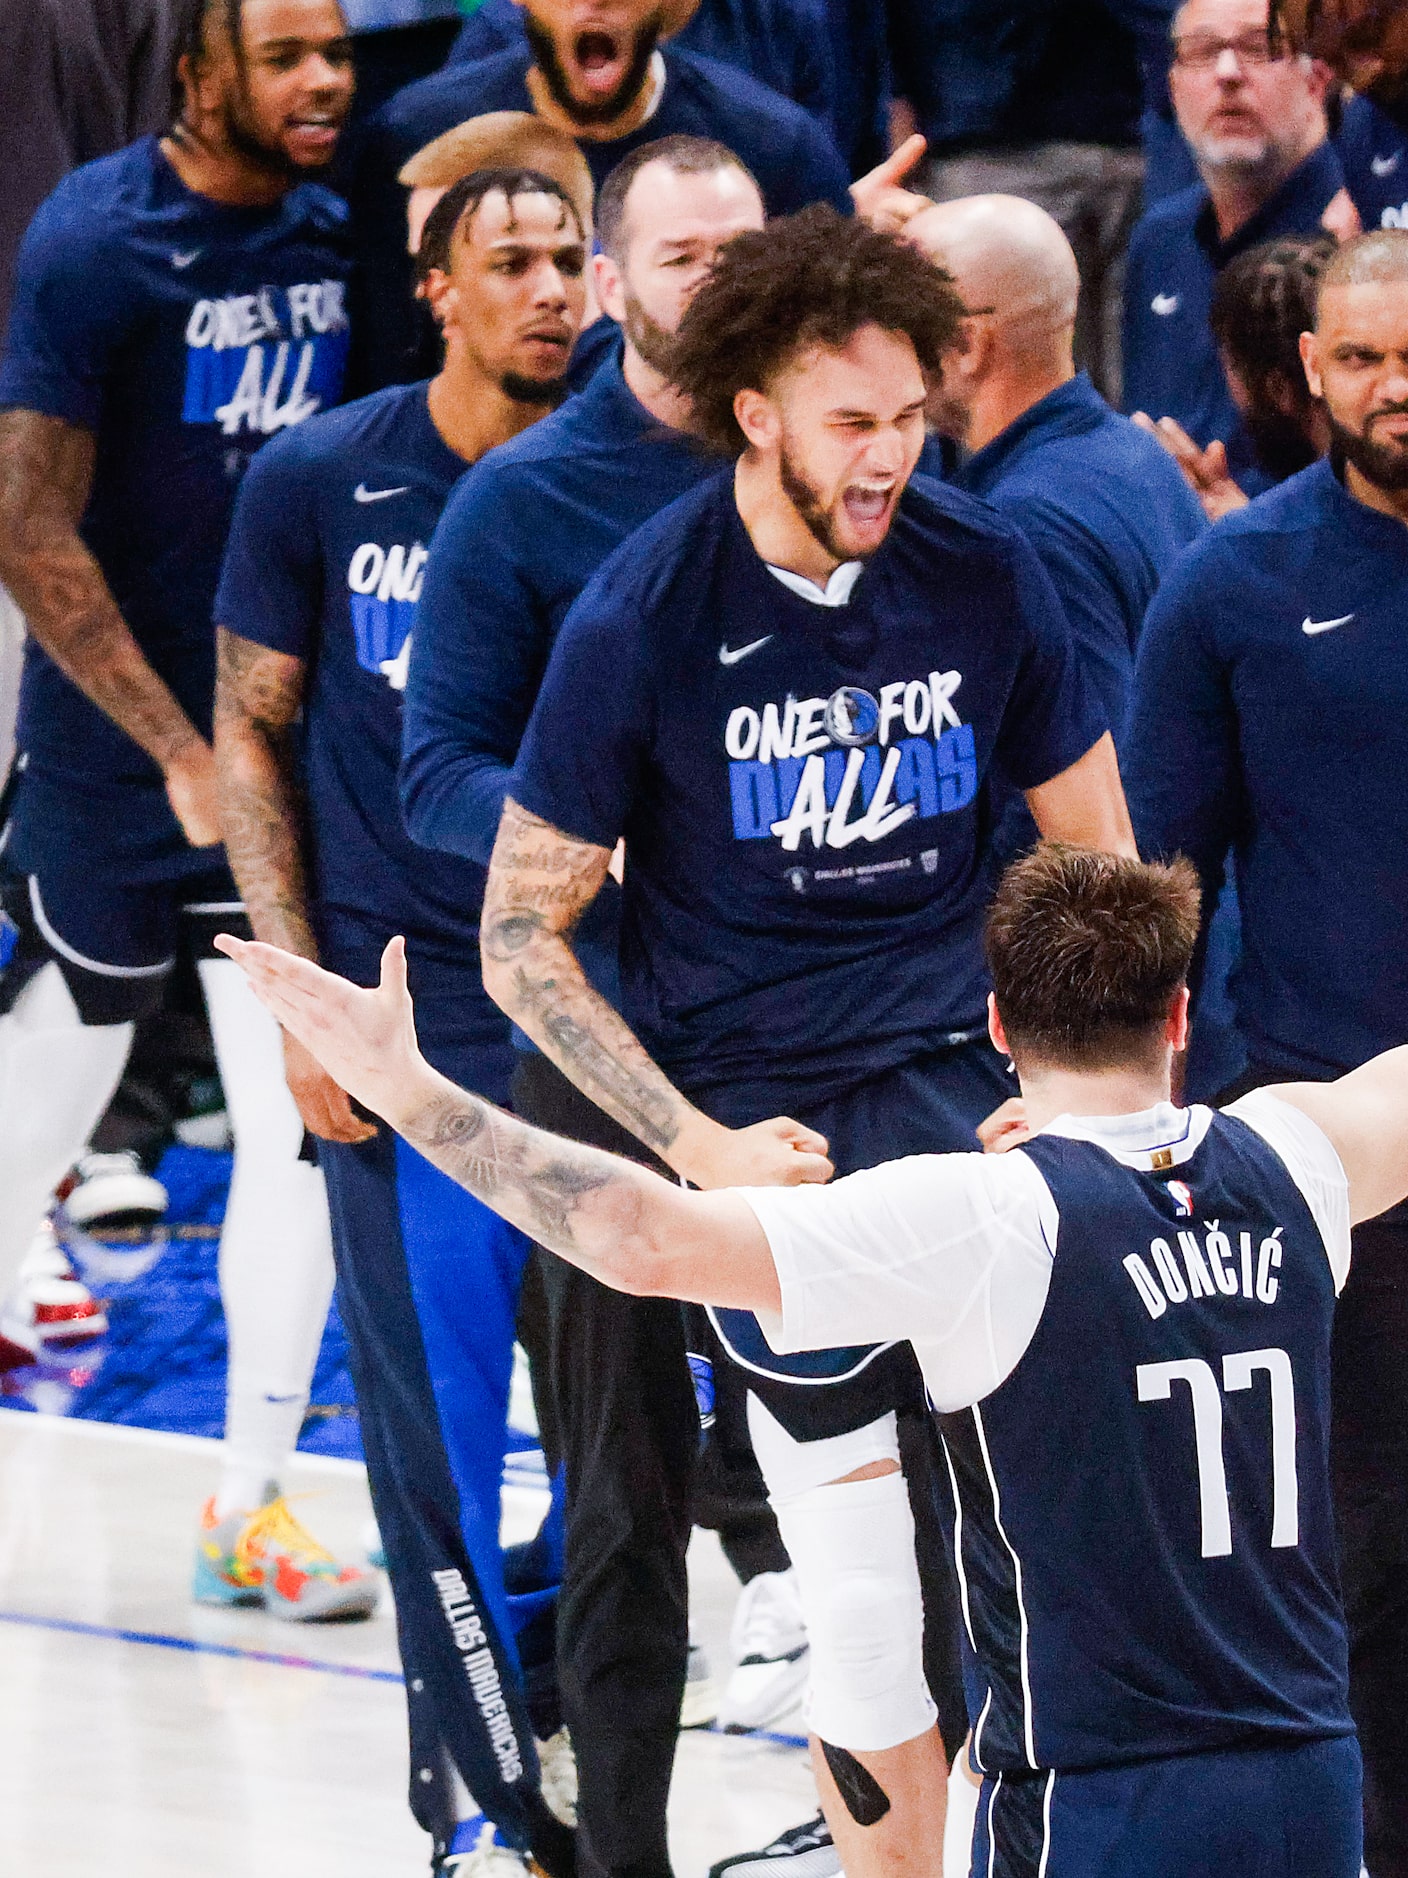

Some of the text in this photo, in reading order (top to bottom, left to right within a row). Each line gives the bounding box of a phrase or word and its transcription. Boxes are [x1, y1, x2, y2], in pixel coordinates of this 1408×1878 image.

[288, 278, 347, 338] FOR
[214, 341, 322, 436] ALL
[725, 670, 962, 764] ONE FOR
[770, 747, 917, 851] ALL
[1122, 1219, 1284, 1320] DONČIĆ
[1136, 1348, 1299, 1557] 77
[430, 1567, 524, 1784] DALLAS MAVERICKS
